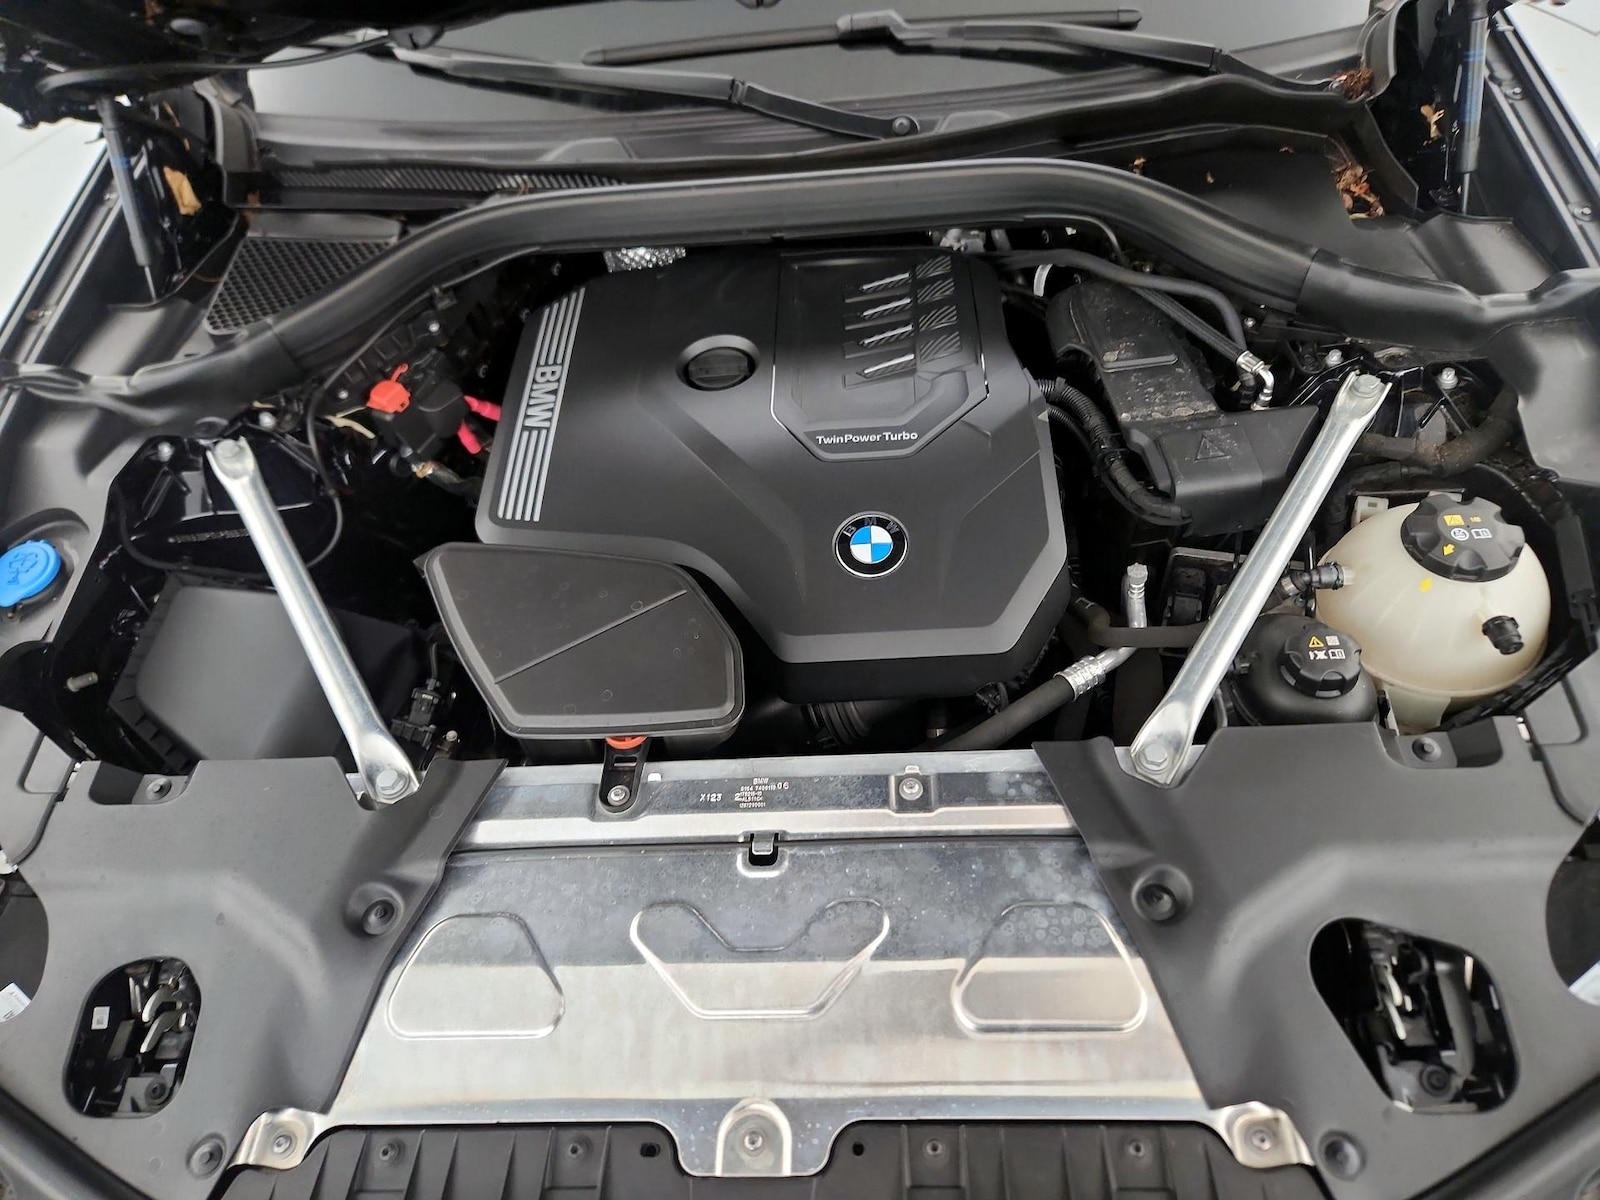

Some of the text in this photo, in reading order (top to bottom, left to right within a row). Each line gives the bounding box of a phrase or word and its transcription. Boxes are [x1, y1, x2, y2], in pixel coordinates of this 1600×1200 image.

[523, 364, 563, 428] BMW
[815, 431, 918, 445] TwinPower Turbo
[843, 517, 900, 537] BMW
[699, 793, 722, 802] X123
